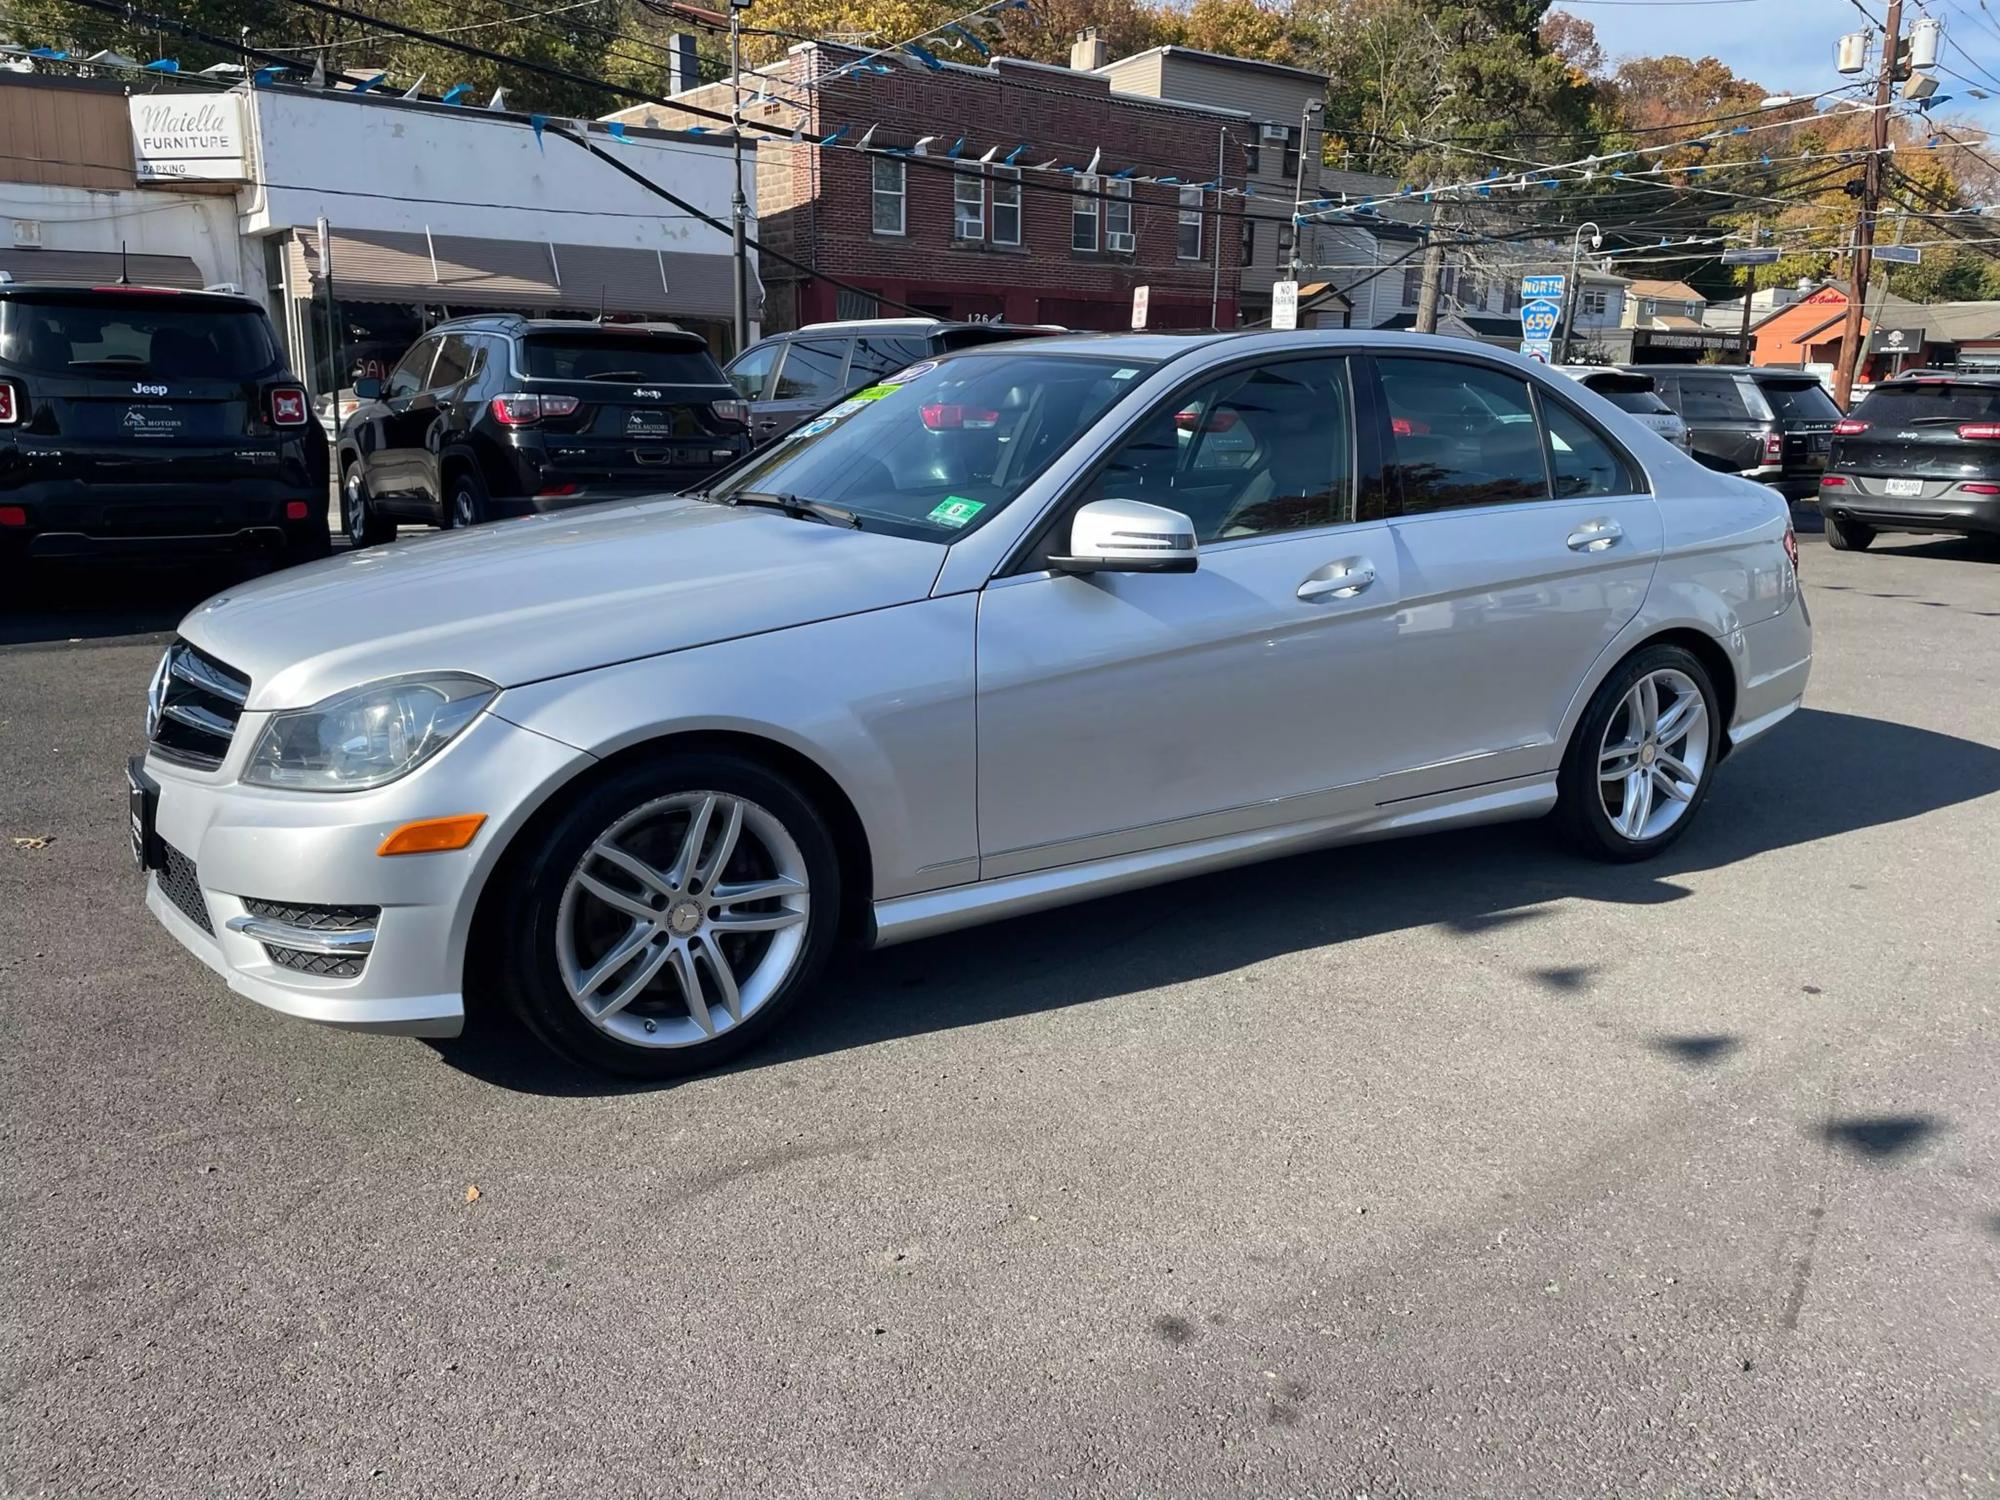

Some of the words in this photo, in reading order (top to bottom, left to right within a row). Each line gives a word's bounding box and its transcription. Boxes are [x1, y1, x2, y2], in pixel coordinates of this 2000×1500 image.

[141, 105, 225, 133] Maiella
[143, 137, 229, 150] FURNITURE
[143, 165, 186, 174] PARKING
[1280, 285, 1291, 295] NO
[1523, 281, 1562, 294] NORTH
[968, 313, 989, 323] 126
[1526, 313, 1554, 330] 659
[132, 382, 168, 396] Jeep
[633, 388, 662, 399] Jeep
[1897, 431, 1918, 439] Jeep
